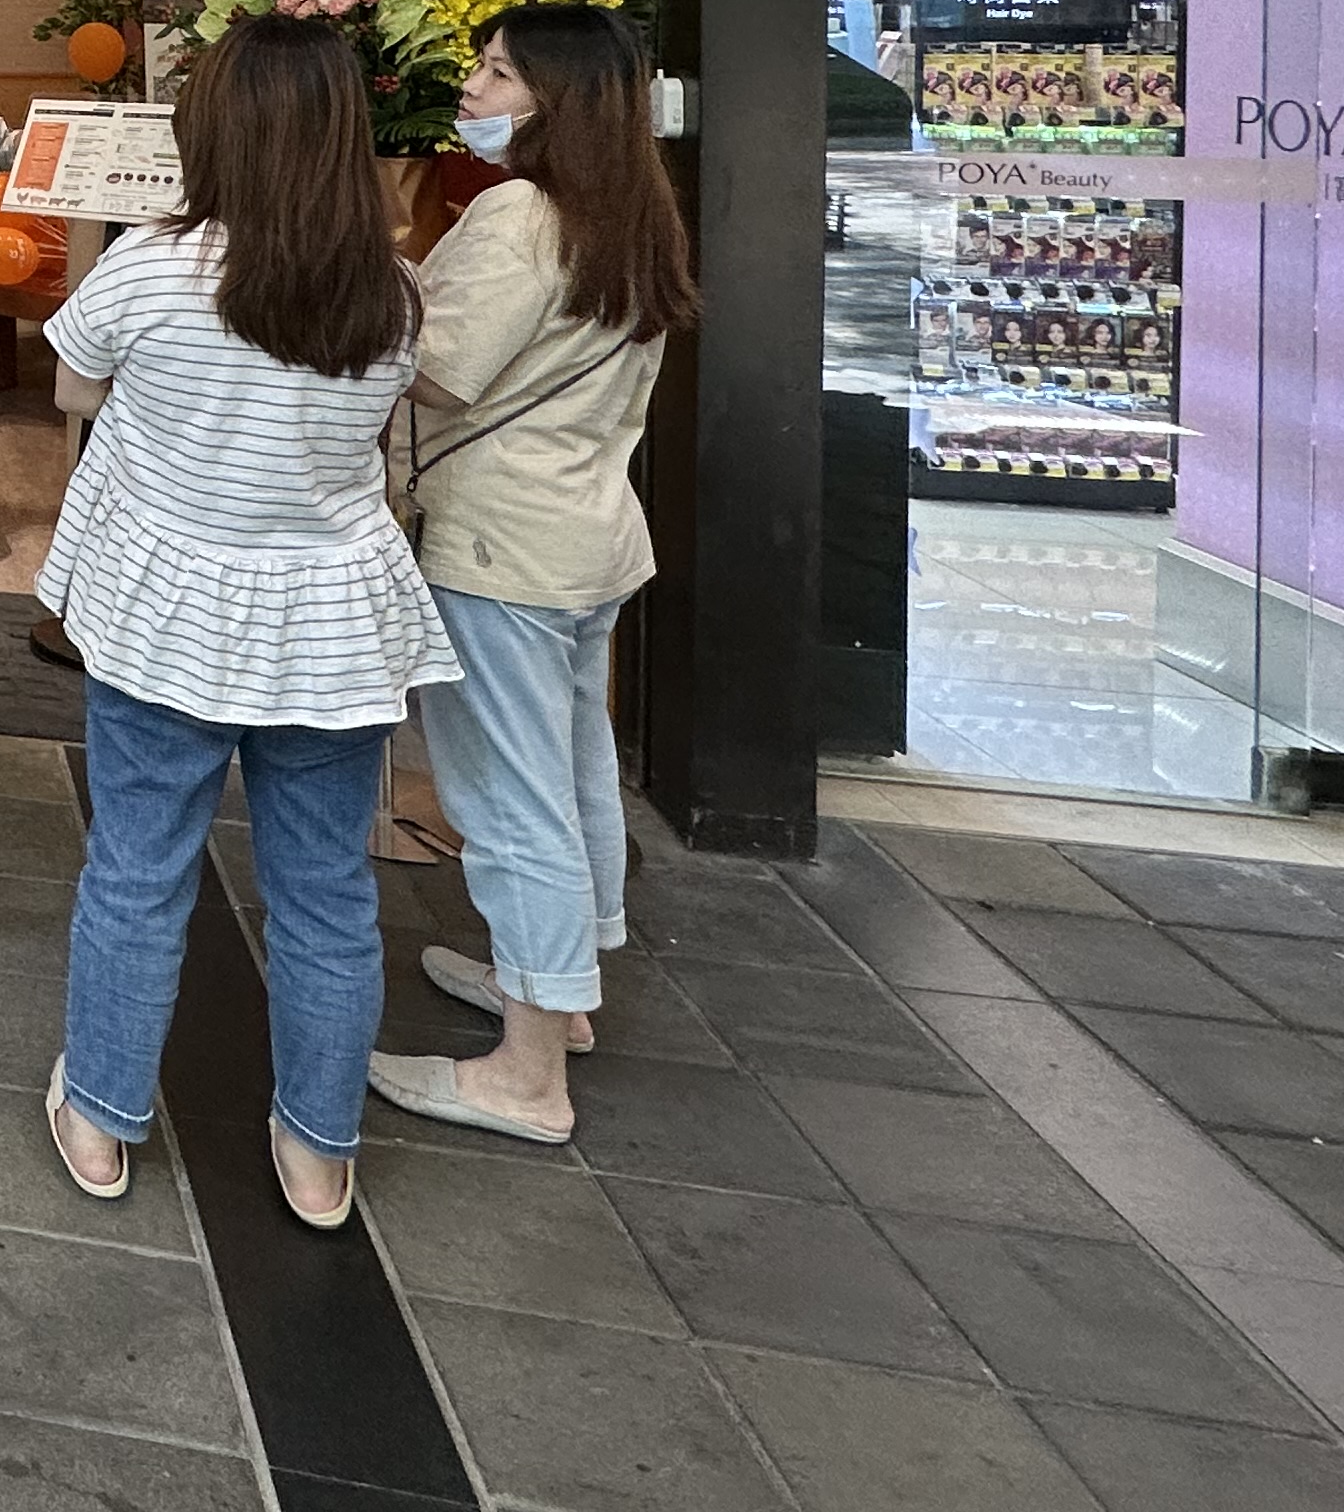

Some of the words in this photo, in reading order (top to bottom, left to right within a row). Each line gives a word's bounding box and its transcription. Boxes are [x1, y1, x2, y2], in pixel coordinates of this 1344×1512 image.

[986, 7, 1010, 19] Hair
[1011, 8, 1034, 20] Dye
[1234, 95, 1344, 157] POY
[938, 162, 1027, 185] POYA
[1040, 170, 1113, 191] Beauty
